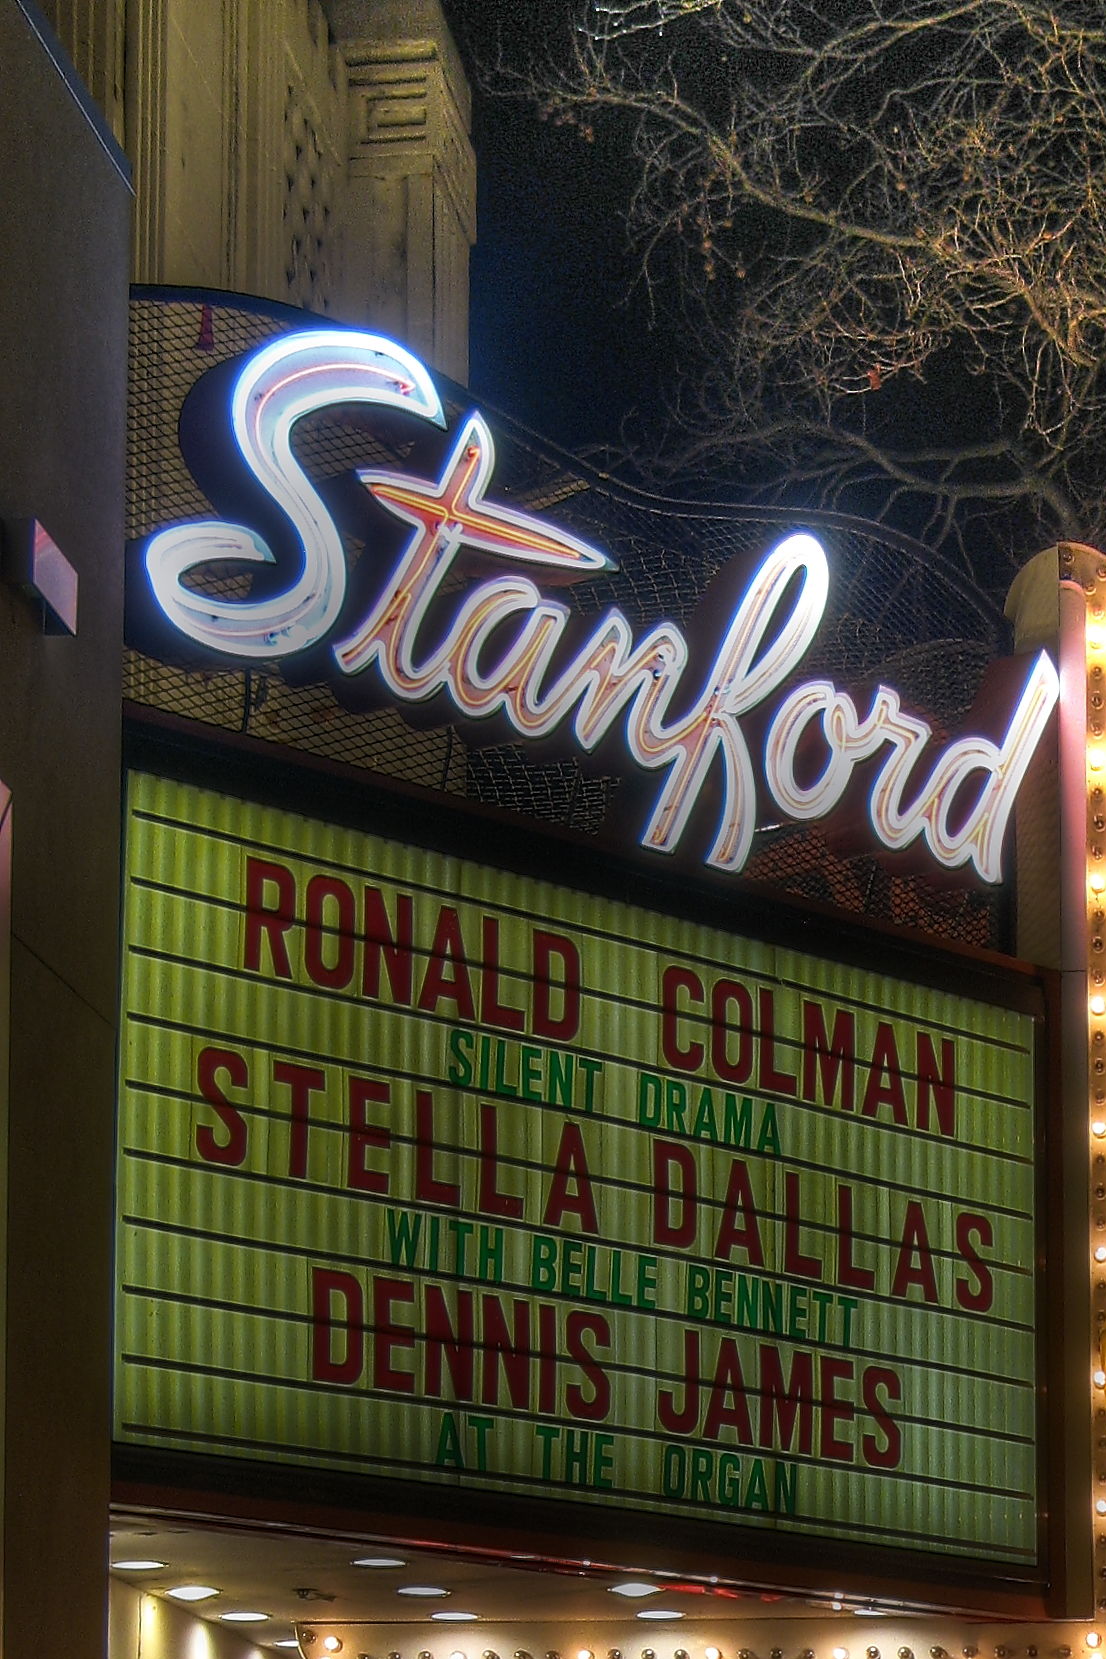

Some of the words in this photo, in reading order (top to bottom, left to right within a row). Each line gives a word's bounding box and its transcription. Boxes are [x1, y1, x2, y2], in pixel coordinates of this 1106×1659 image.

[146, 328, 1060, 885] Stanford
[244, 857, 580, 1041] RONALD
[662, 966, 955, 1137] COLMAN
[448, 1030, 603, 1113] SILENT
[638, 1072, 782, 1160] DRAMA
[196, 1047, 597, 1233] STELLA
[654, 1140, 993, 1313] DALLAS
[387, 1208, 504, 1285] WITH
[530, 1234, 657, 1310] BELLE
[687, 1264, 859, 1348] BENNETT
[313, 1267, 611, 1422] DENNIS
[658, 1328, 902, 1469] JAMES
[436, 1412, 495, 1470] AT
[535, 1424, 615, 1488] THE
[663, 1445, 798, 1513] ORGAN
